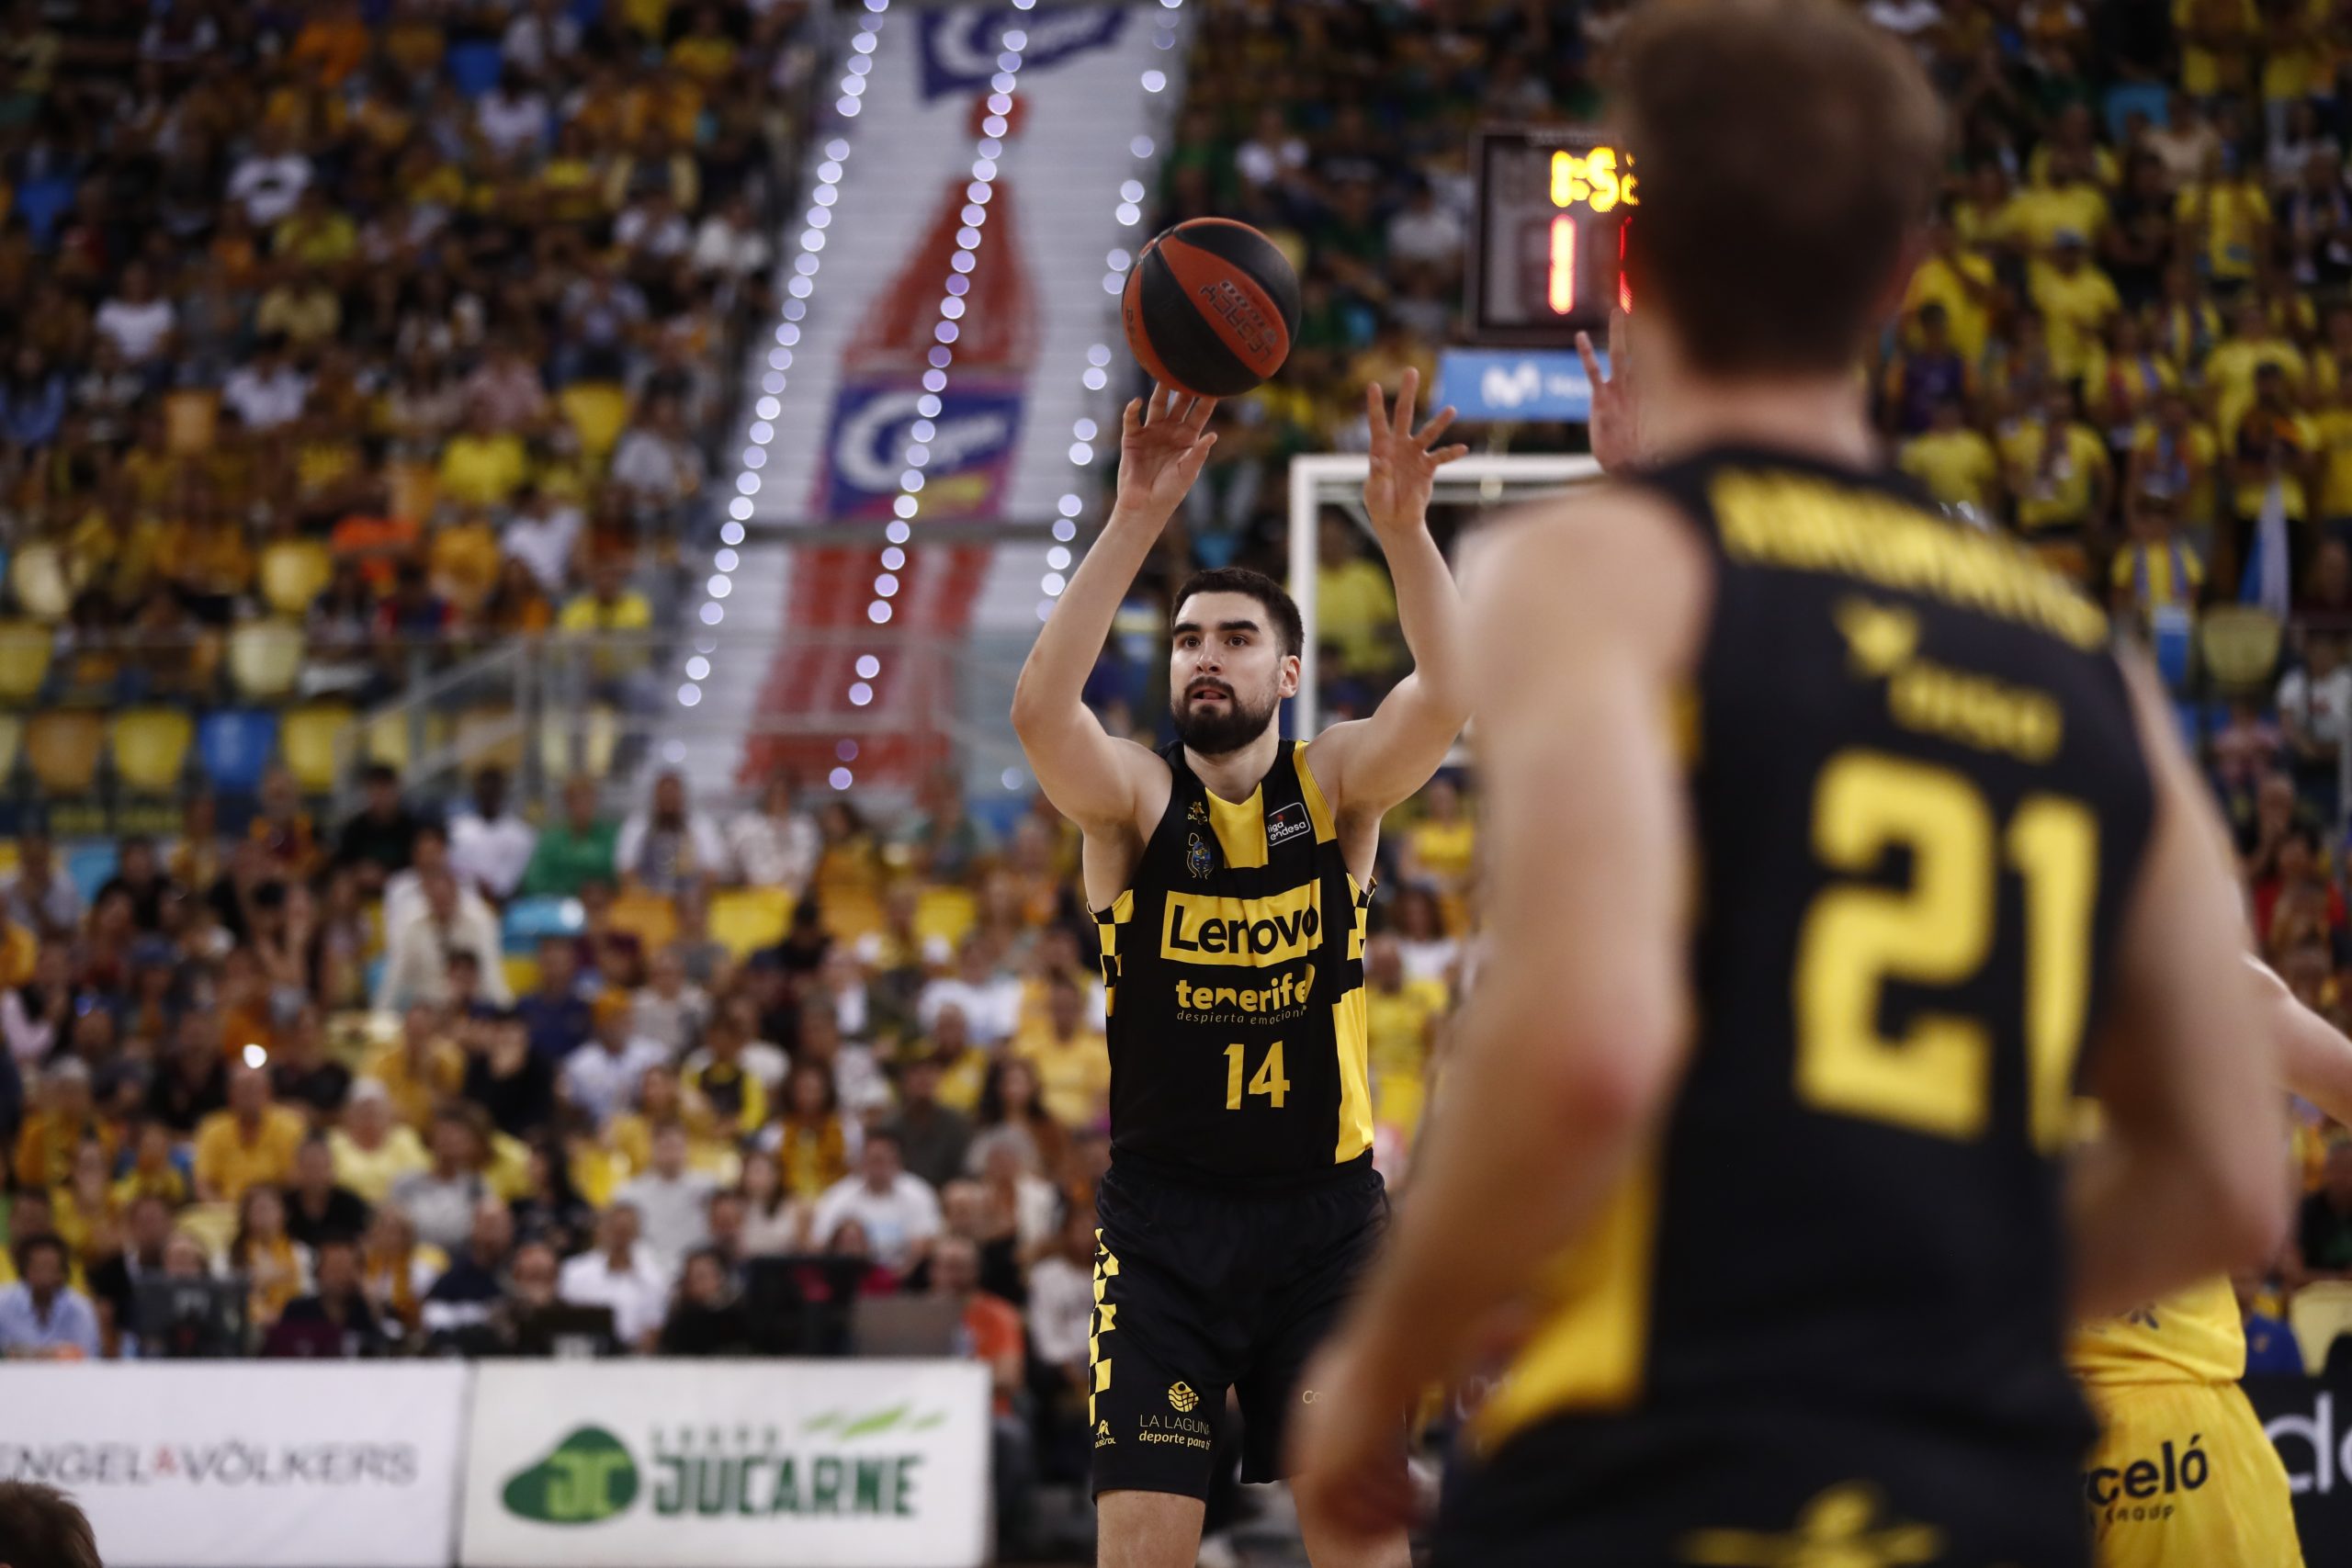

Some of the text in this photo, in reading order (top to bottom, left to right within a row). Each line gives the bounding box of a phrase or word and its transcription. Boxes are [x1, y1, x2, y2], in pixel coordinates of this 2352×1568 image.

[1549, 214, 1633, 314] 1
[1268, 821, 1284, 833] liga
[1270, 821, 1306, 840] endesa
[1170, 904, 1319, 955] Lenovo
[1795, 750, 2098, 1154] 21
[1176, 1010, 1245, 1024] despierta
[1223, 1040, 1290, 1110] 14
[1139, 1415, 1160, 1427] LA
[1138, 1429, 1185, 1444] deporte
[1187, 1437, 1205, 1449] para
[2080, 1434, 2209, 1506] celó
